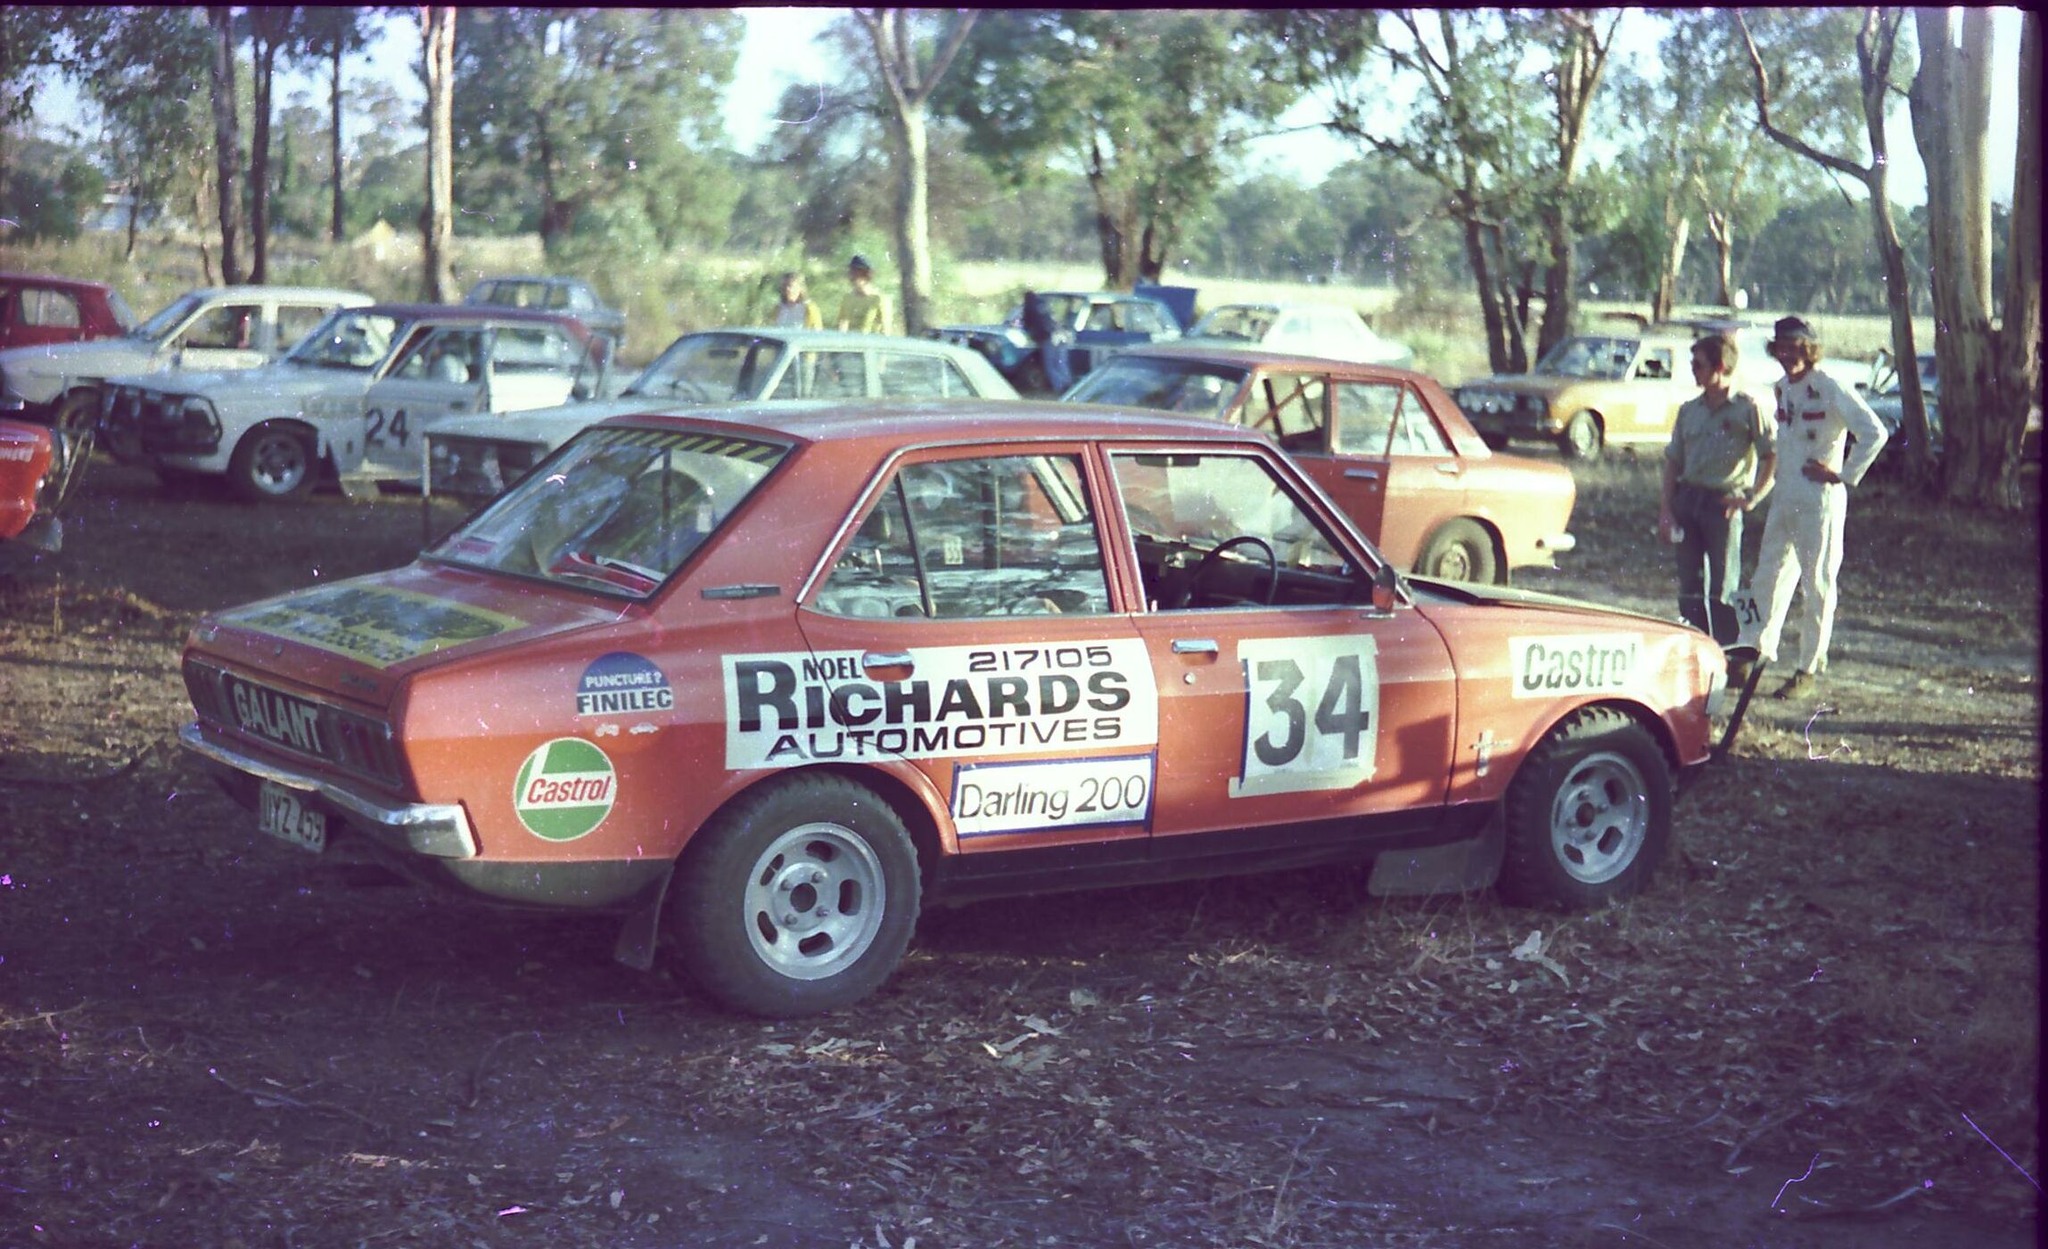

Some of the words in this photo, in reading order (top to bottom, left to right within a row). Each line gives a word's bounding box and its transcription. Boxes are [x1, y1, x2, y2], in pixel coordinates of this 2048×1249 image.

[366, 407, 409, 447] 24
[802, 656, 862, 682] NOEL
[969, 646, 1113, 672] 217105
[585, 671, 663, 689] PUNCTURE?
[735, 660, 1131, 732] RICHARDS
[233, 682, 322, 753] GALANT
[576, 689, 673, 714] FINILEC
[1254, 654, 1370, 767] 34
[764, 716, 1122, 762] AUTOMOTIVES
[527, 775, 611, 805] Castrol
[958, 782, 1070, 821] Darling
[1074, 774, 1147, 814] 200
